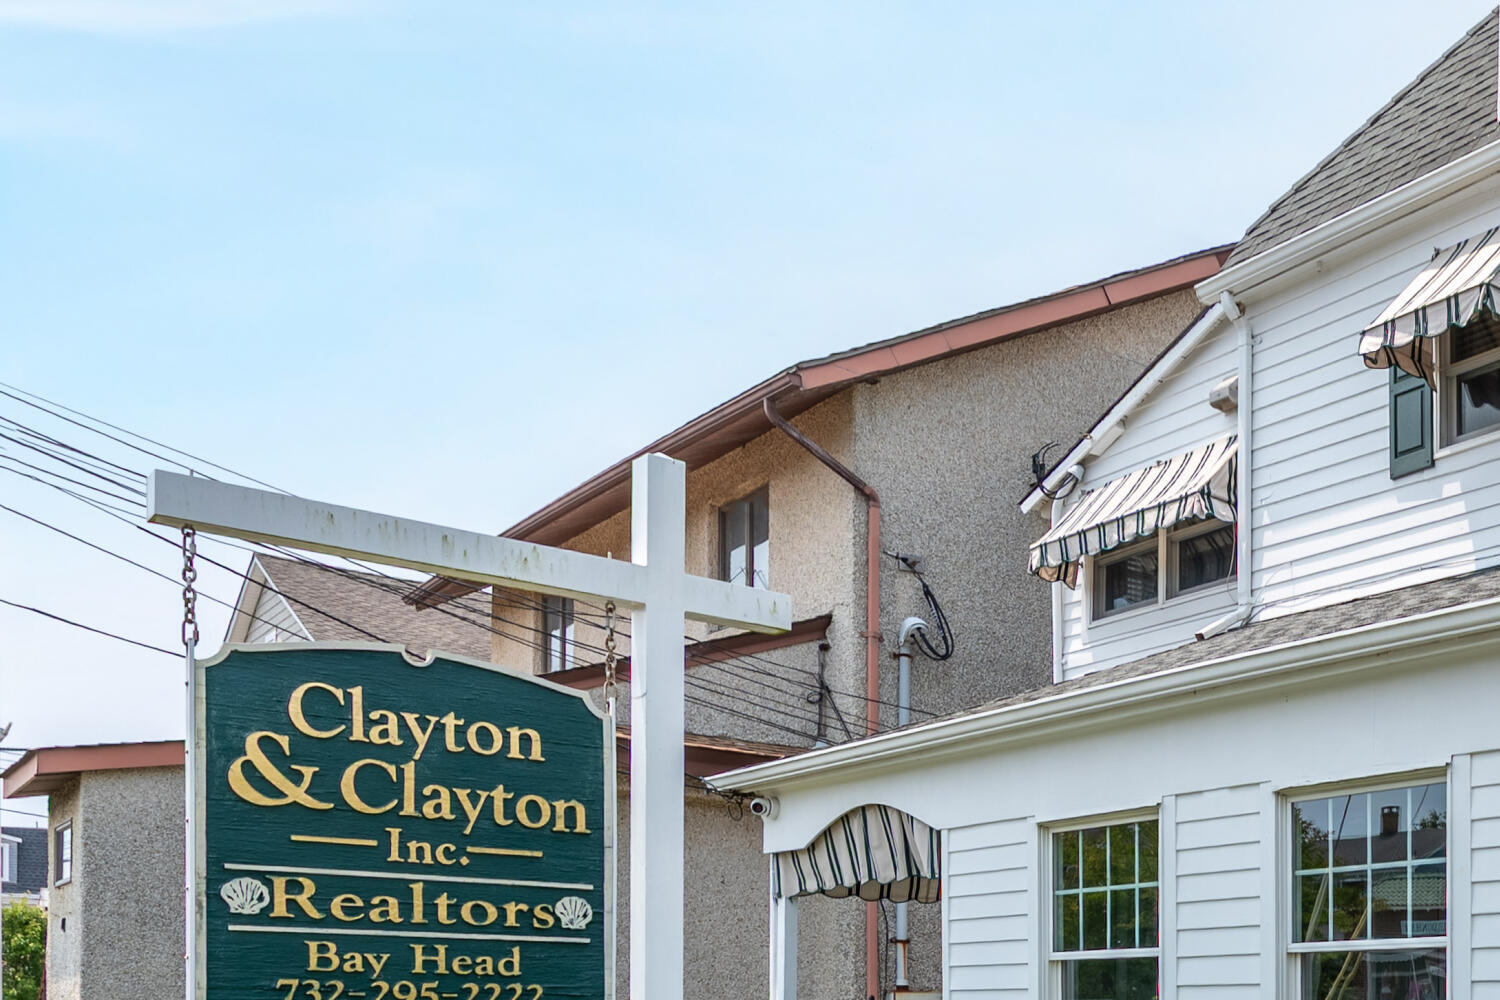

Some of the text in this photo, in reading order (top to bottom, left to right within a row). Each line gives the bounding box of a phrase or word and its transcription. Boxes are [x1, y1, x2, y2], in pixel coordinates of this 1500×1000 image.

[288, 681, 545, 761] Clayton
[227, 731, 591, 835] & Clayton
[385, 828, 470, 866] Inc.
[267, 876, 555, 928] Realtors
[305, 940, 523, 979] Bay Head
